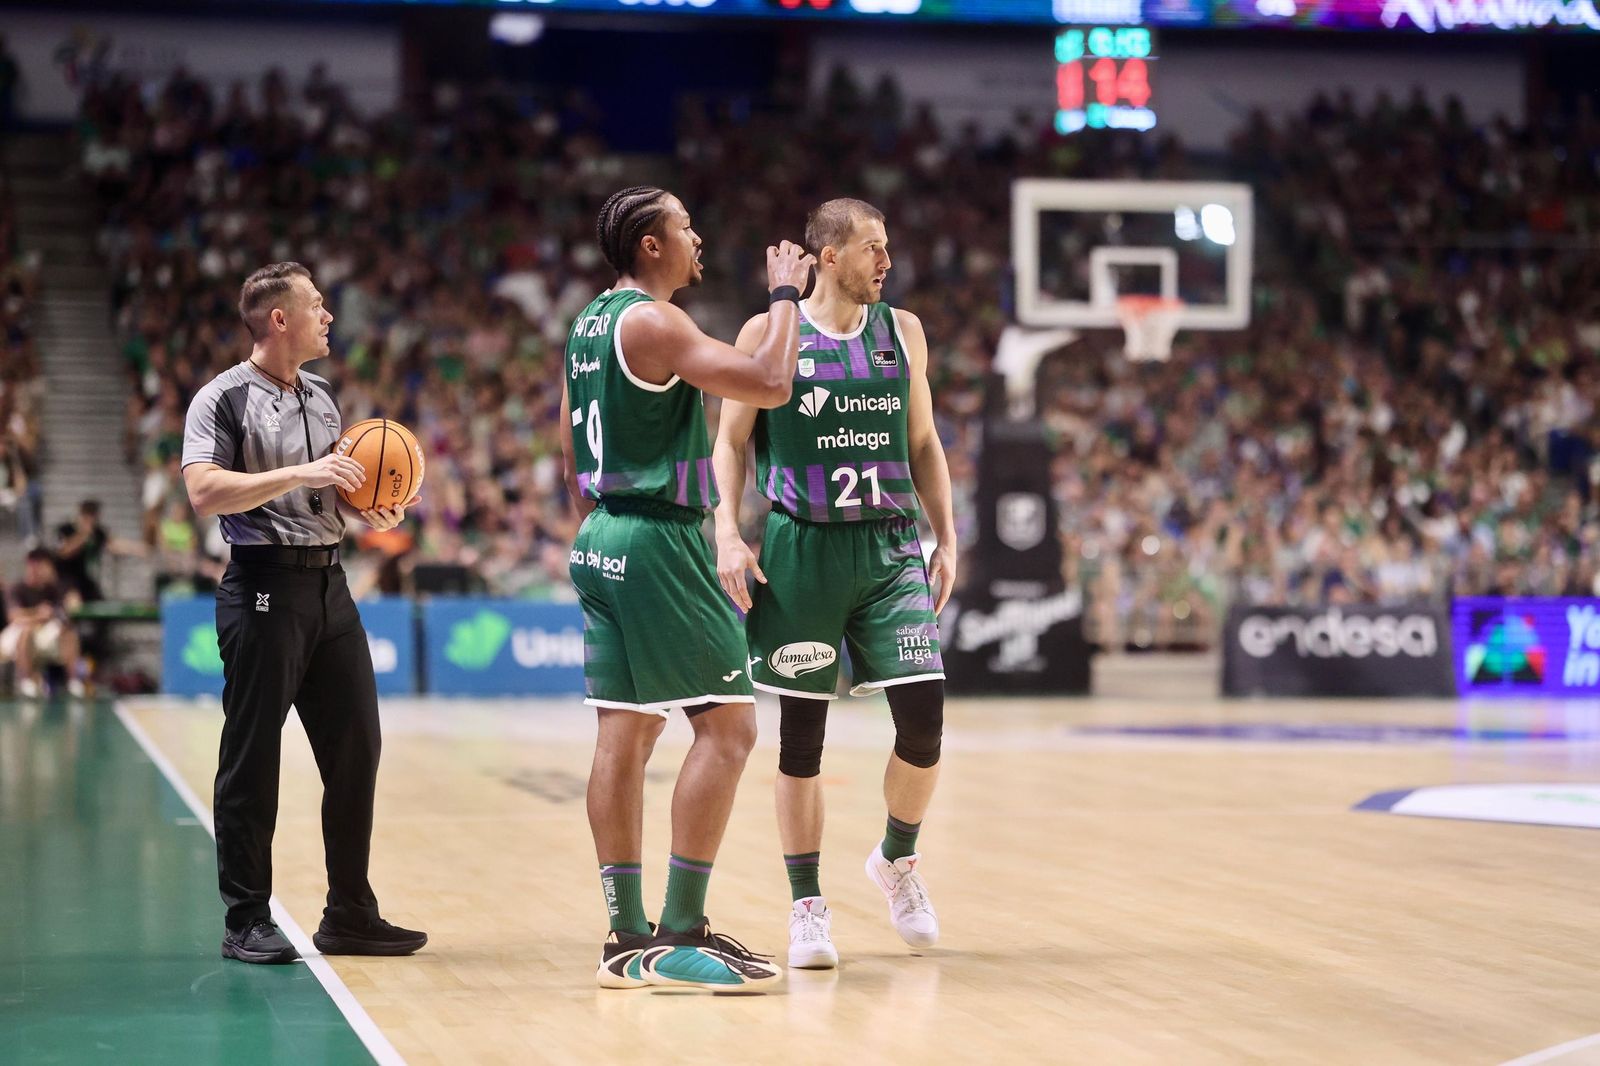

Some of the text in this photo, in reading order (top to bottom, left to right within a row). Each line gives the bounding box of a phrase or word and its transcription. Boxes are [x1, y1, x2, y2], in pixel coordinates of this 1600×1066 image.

[834, 393, 901, 415] Unicaja
[831, 465, 882, 508] 21
[602, 555, 627, 574] sol
[896, 625, 921, 636] sabor
[1238, 606, 1438, 658] endesa
[898, 646, 933, 665] laga
[602, 876, 620, 918] UNICAJA
